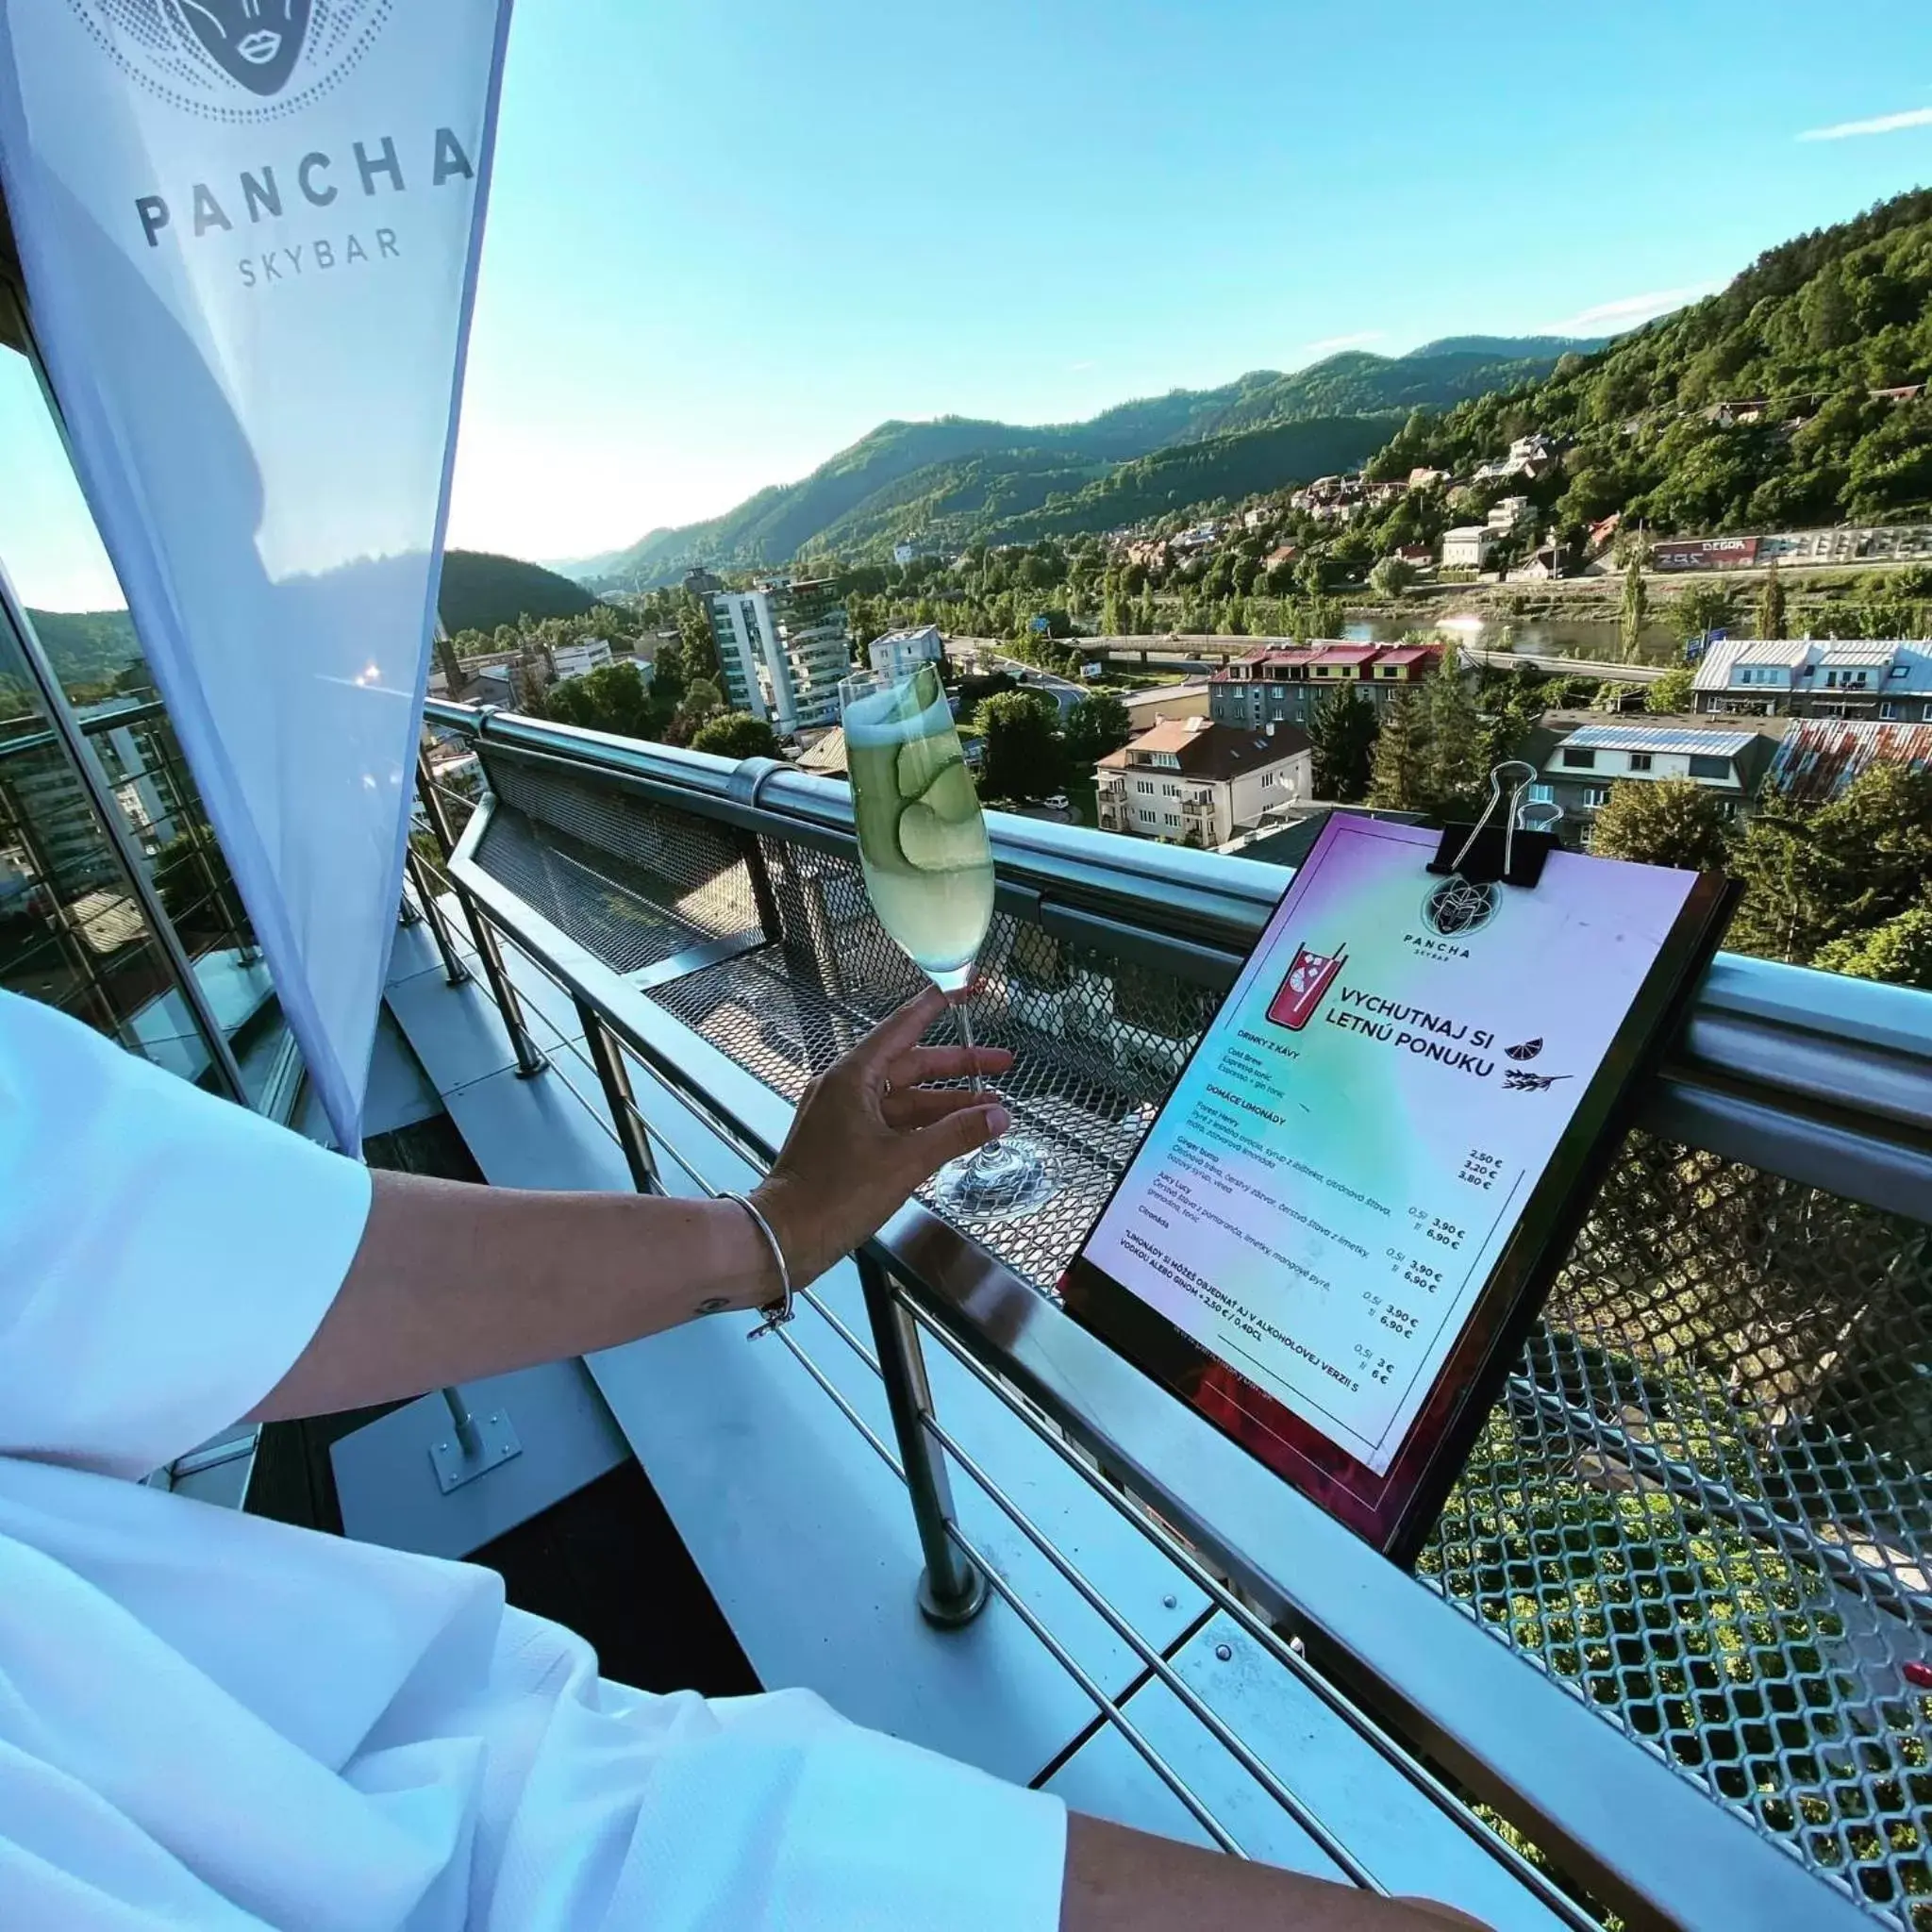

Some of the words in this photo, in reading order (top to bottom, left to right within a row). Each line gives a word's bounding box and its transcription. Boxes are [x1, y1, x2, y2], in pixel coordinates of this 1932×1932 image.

[136, 127, 474, 247] PANCHA
[239, 227, 400, 286] SKYBAR
[1403, 934, 1470, 959] PANCHA
[1341, 986, 1469, 1041] VYCHUTNAJ
[1469, 1029, 1495, 1050] SI
[1237, 1029, 1269, 1047] DRINKY
[1267, 1041, 1276, 1051] Z
[1324, 1007, 1394, 1042] LETNÚ
[1393, 1031, 1495, 1077] PONUKU
[1241, 1099, 1287, 1125] LIMONÁDY
[1493, 1159, 1503, 1169] €
[1488, 1170, 1498, 1180] €
[1482, 1181, 1492, 1191] €
[1457, 1229, 1466, 1240] €
[1451, 1241, 1460, 1250] €
[1434, 1273, 1443, 1283] €
[1148, 1259, 1174, 1279] ALEBO
[1173, 1274, 1199, 1297] GINOM
[1221, 1308, 1229, 1318] €
[1427, 1284, 1438, 1293] €
[1162, 1255, 1172, 1265] SI
[1236, 1306, 1250, 1318] AJ
[1249, 1312, 1257, 1323] V
[1255, 1319, 1321, 1366] ALKOHOLOVEJ
[1321, 1361, 1352, 1388] VERZII
[1350, 1382, 1359, 1393] S
[1409, 1318, 1420, 1328] €
[1404, 1329, 1413, 1340] €
[1376, 1357, 1386, 1369] 3
[1386, 1364, 1395, 1374] €
[1371, 1369, 1380, 1379] 6
[1379, 1374, 1390, 1385] €
